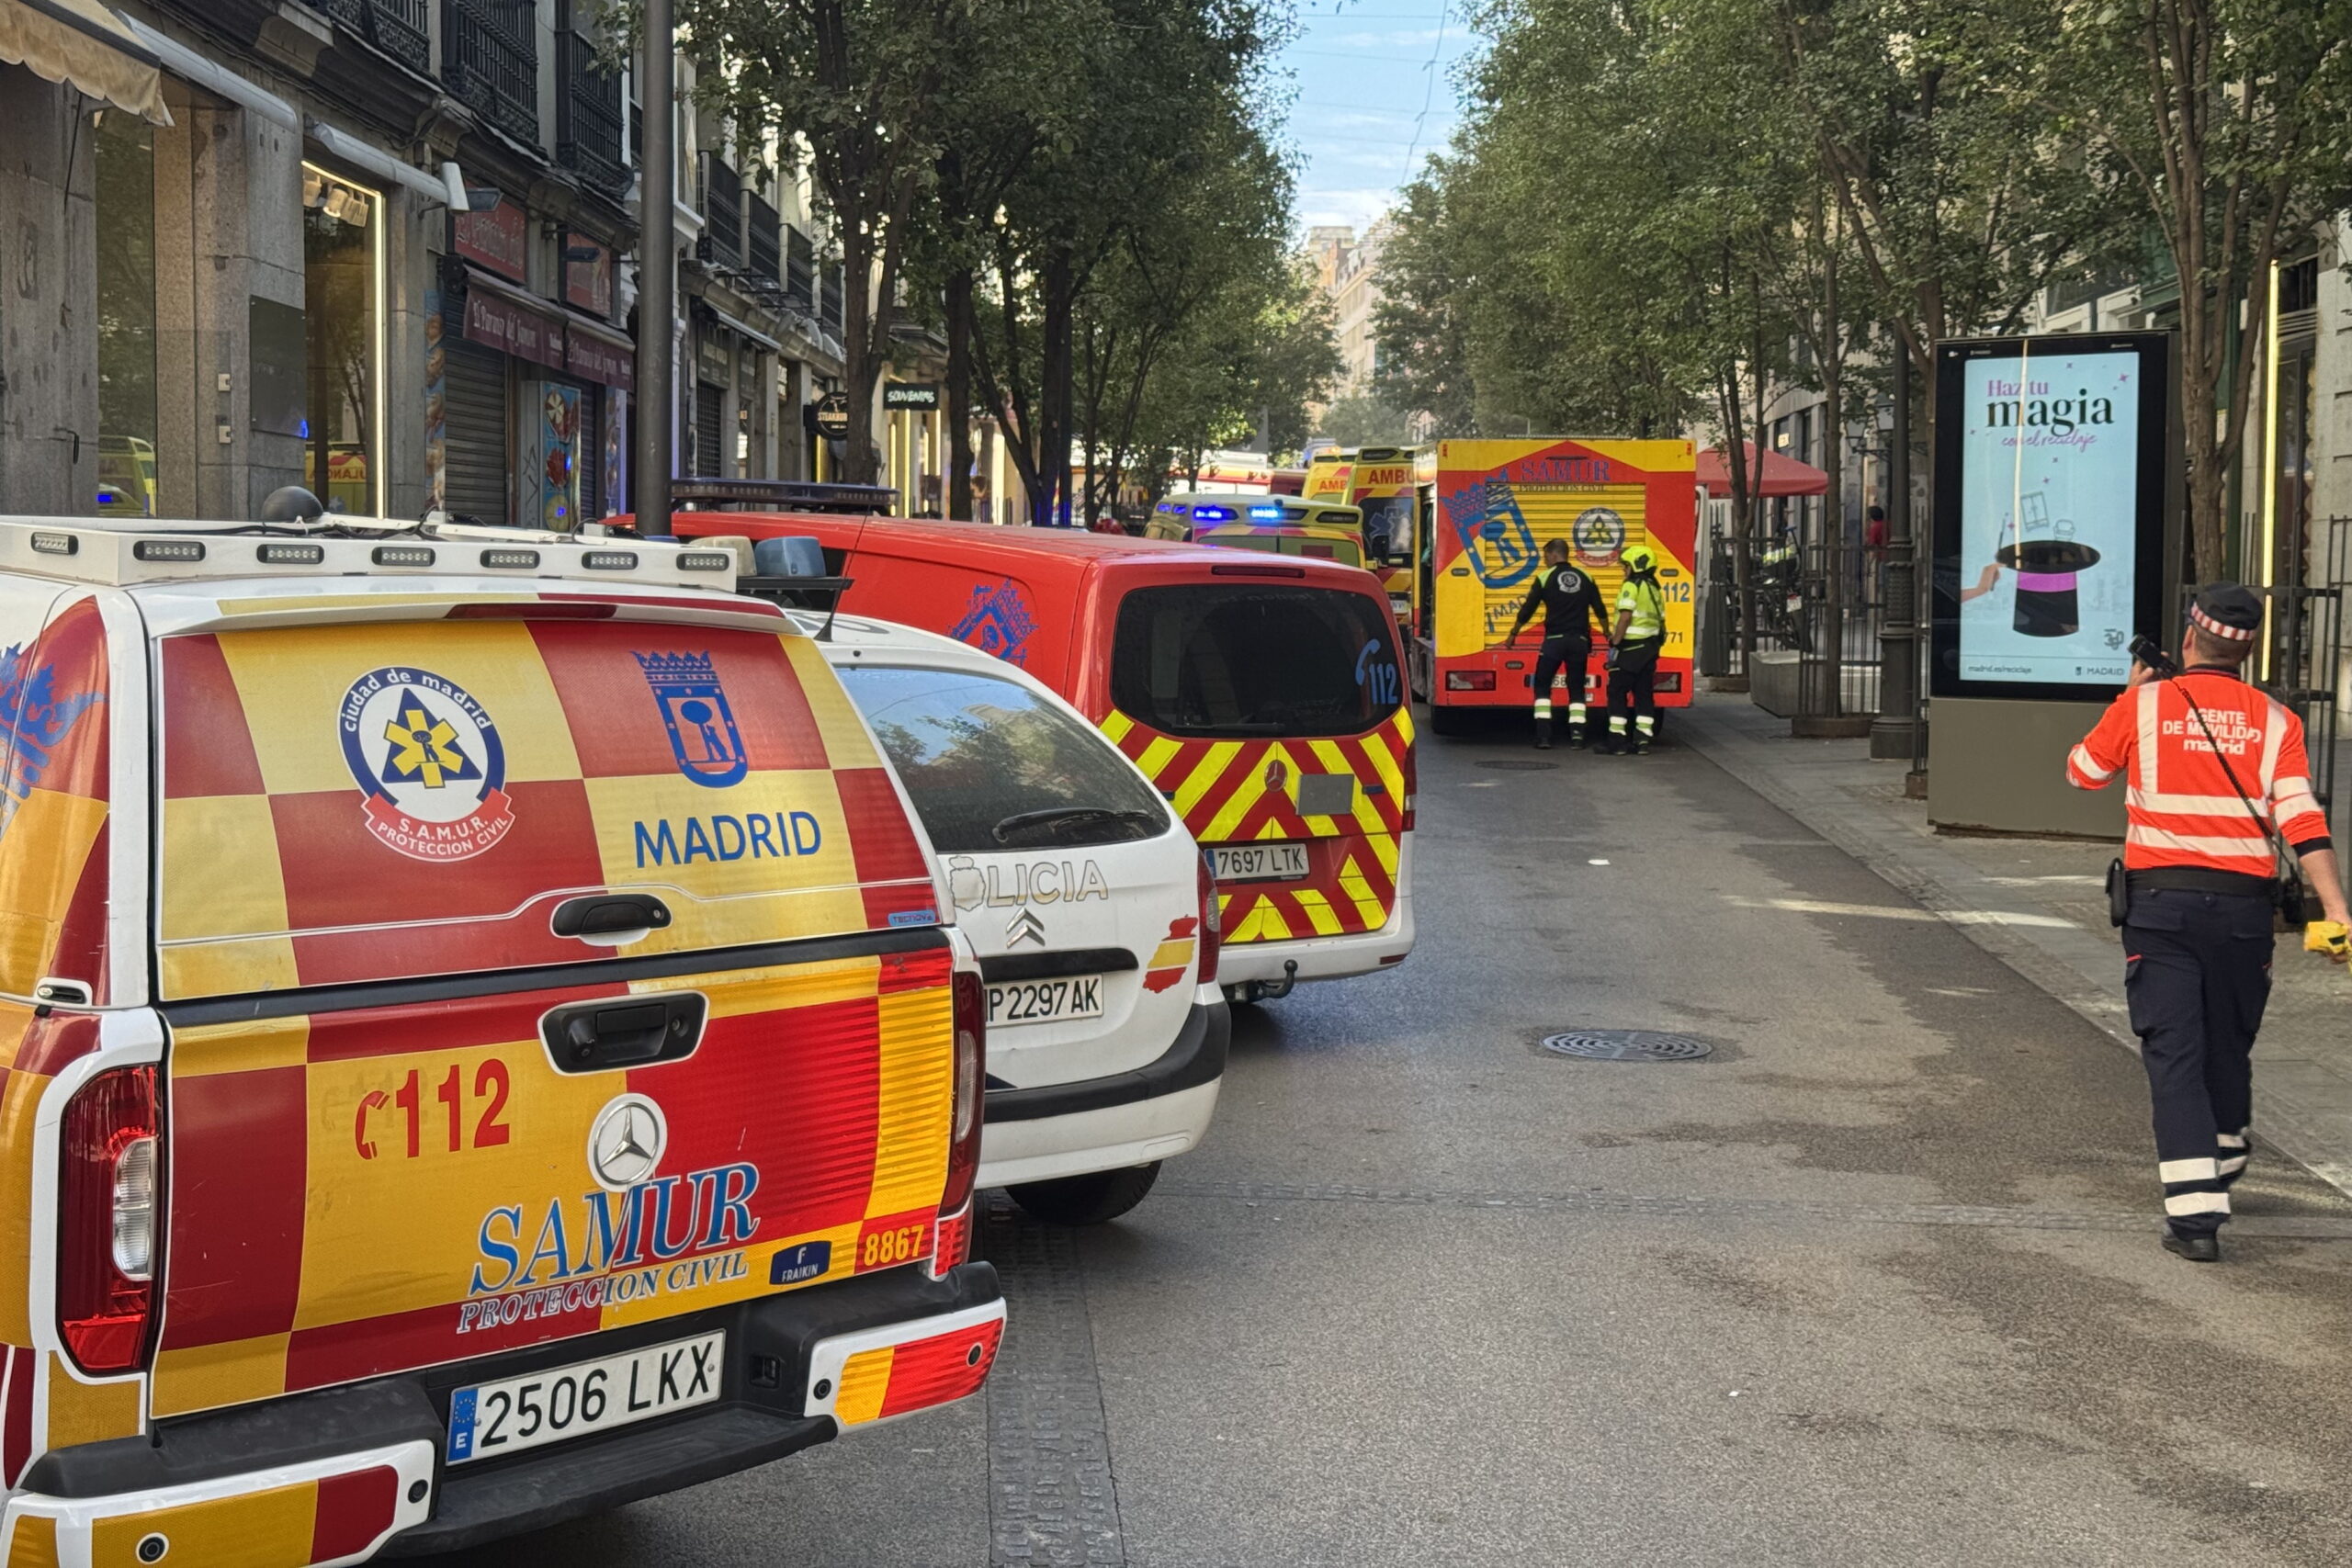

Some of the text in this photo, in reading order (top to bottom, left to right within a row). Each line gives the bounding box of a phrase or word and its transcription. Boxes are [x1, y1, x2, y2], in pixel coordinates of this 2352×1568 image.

[1987, 379, 2049, 397] Haz tu
[1986, 388, 2115, 437] magia
[1521, 459, 1611, 482] SAMUR
[1663, 581, 1690, 603] 112
[1369, 663, 1398, 705] 112
[2086, 667, 2125, 676] MADRID
[341, 668, 492, 733] ciudad de madrid
[2185, 707, 2247, 726] AGENTE
[2162, 720, 2262, 743] DE MOVILIDAD
[2183, 738, 2246, 756] madrid
[377, 817, 509, 856] PROTECCION CIVIL
[398, 815, 490, 841] S.A.M.U.R.
[634, 811, 822, 868] MADRID
[1218, 848, 1304, 874] 7697 LTK
[395, 1058, 510, 1158] 112
[468, 1161, 762, 1297] SAMUR
[864, 1224, 925, 1267] 8867
[782, 1264, 819, 1282] FRAIKIN
[457, 1252, 750, 1335] PROTECCION CIVIL
[455, 1341, 714, 1450] E 2506 LKX
